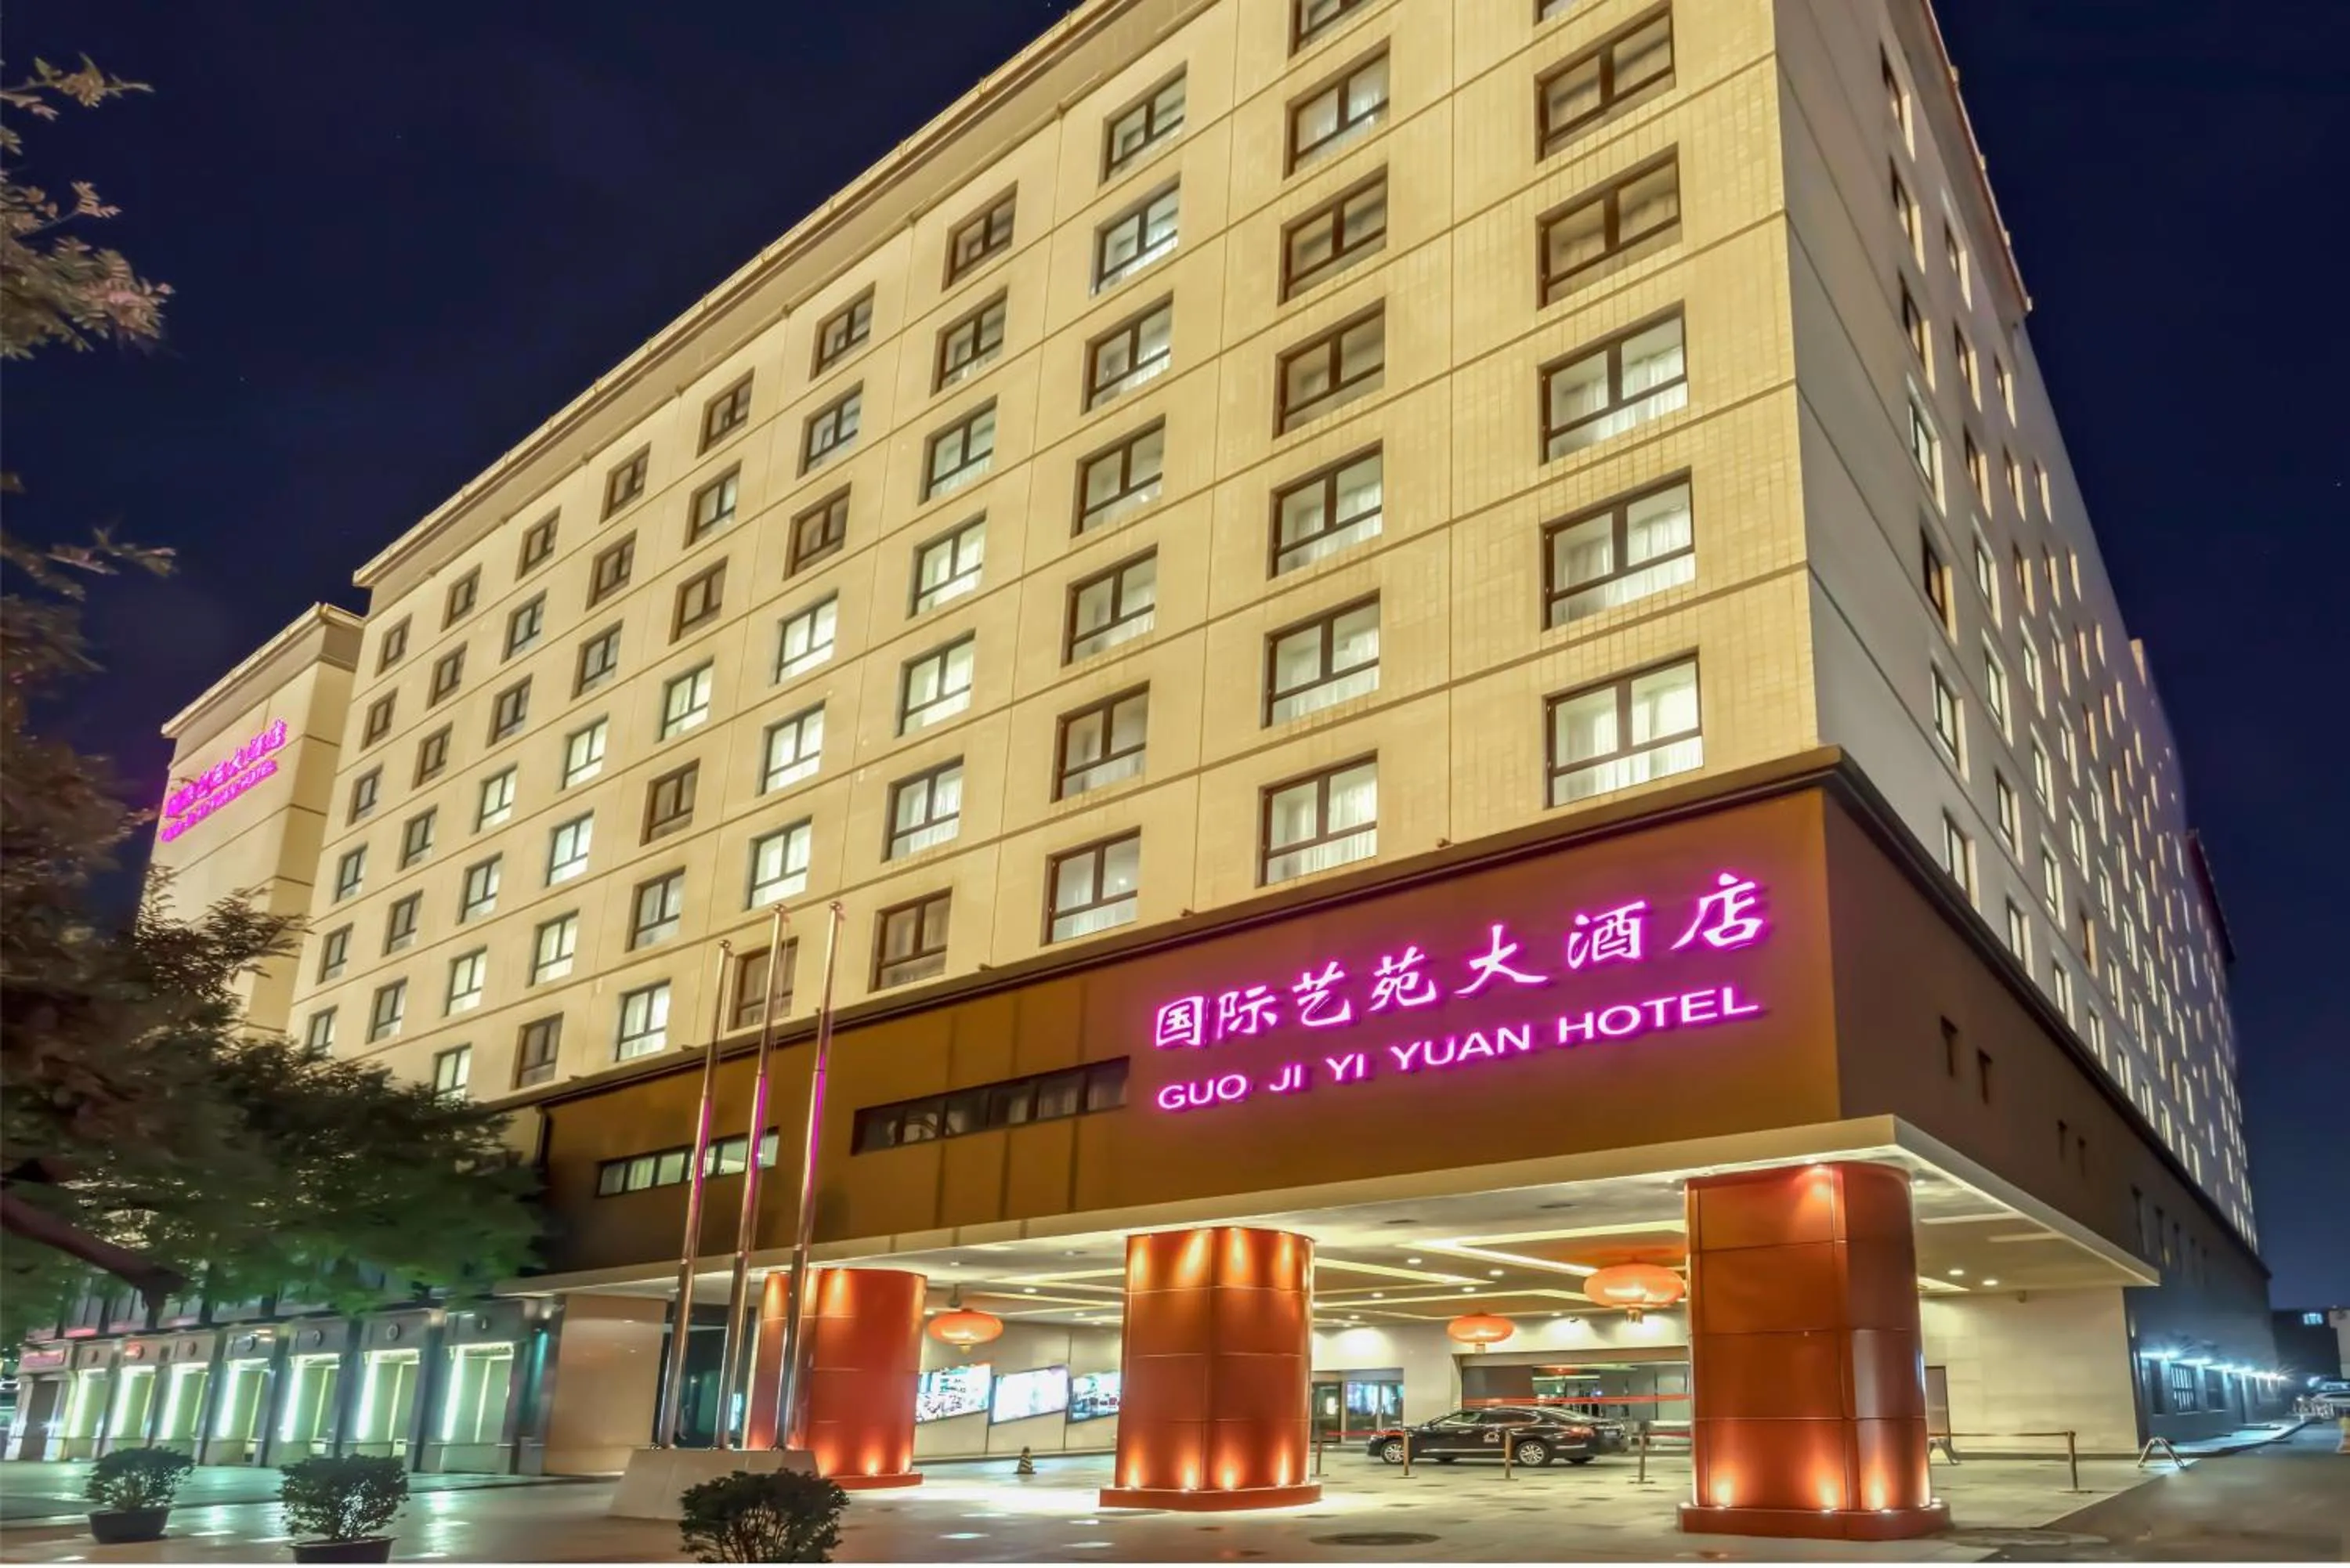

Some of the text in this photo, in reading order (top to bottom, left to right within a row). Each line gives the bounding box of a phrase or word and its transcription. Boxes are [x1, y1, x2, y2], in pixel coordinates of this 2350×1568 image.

[1155, 873, 1762, 1047] 国际艺苑大酒店
[1157, 987, 1759, 1109] GUO JI YI YUAN HOTEL
